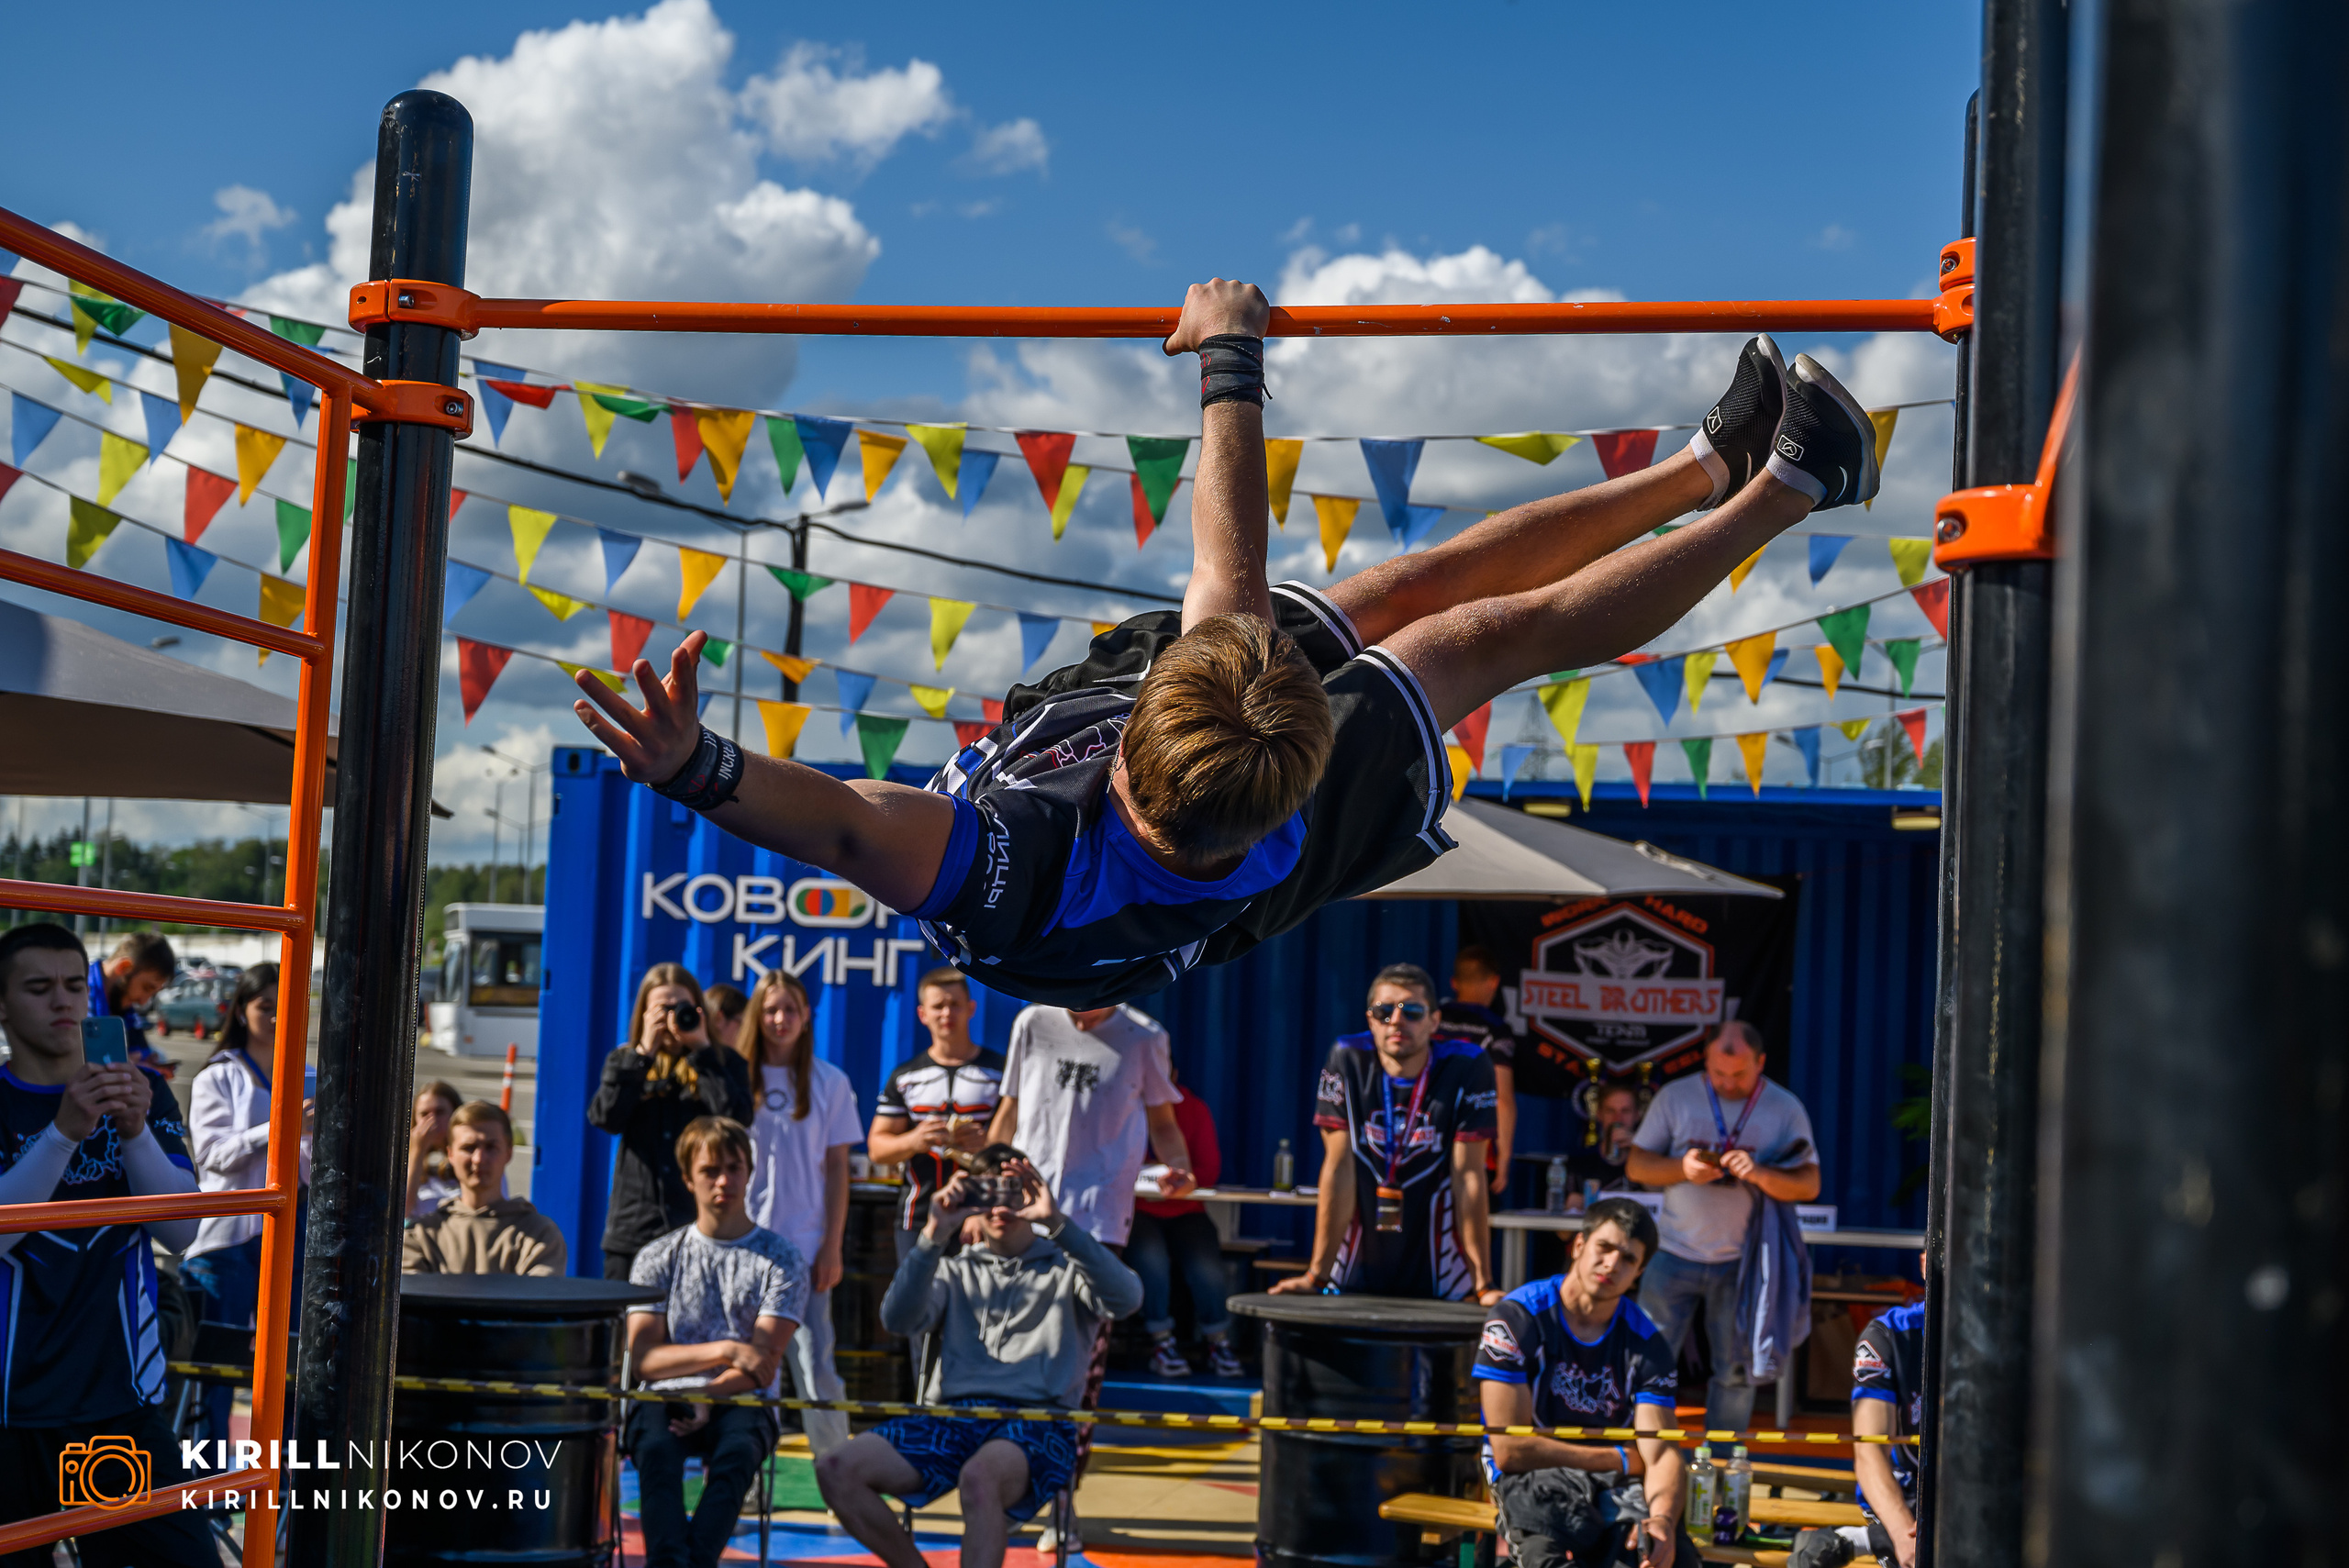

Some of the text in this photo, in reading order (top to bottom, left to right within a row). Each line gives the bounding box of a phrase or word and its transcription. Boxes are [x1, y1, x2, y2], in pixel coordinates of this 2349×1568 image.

[731, 932, 926, 987] КИНГ
[1522, 979, 1720, 1016] STEEL BROTHERS
